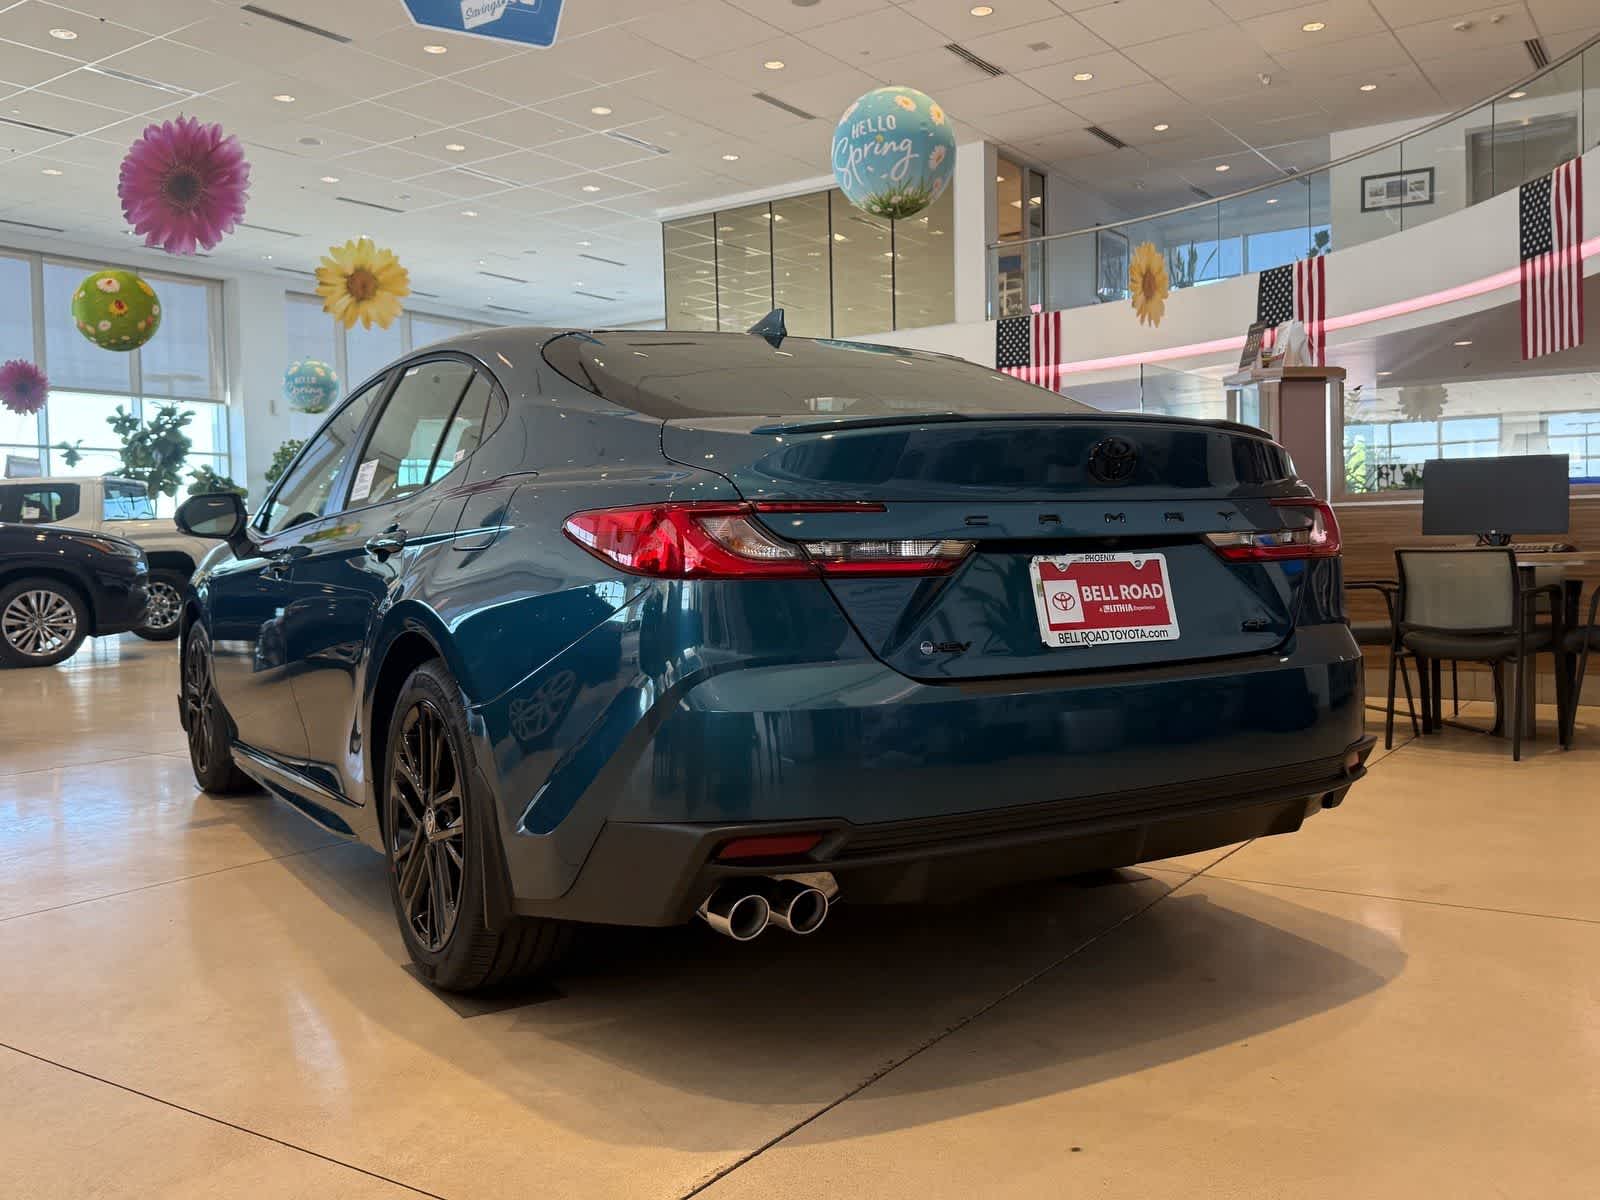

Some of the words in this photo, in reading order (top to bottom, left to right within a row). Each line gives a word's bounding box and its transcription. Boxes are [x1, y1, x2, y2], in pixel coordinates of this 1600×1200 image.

[852, 114, 897, 139] HELLO
[831, 137, 920, 191] Spring
[1084, 553, 1116, 562] PHOENIX
[1081, 585, 1119, 602] BELL
[1119, 583, 1164, 600] ROAD
